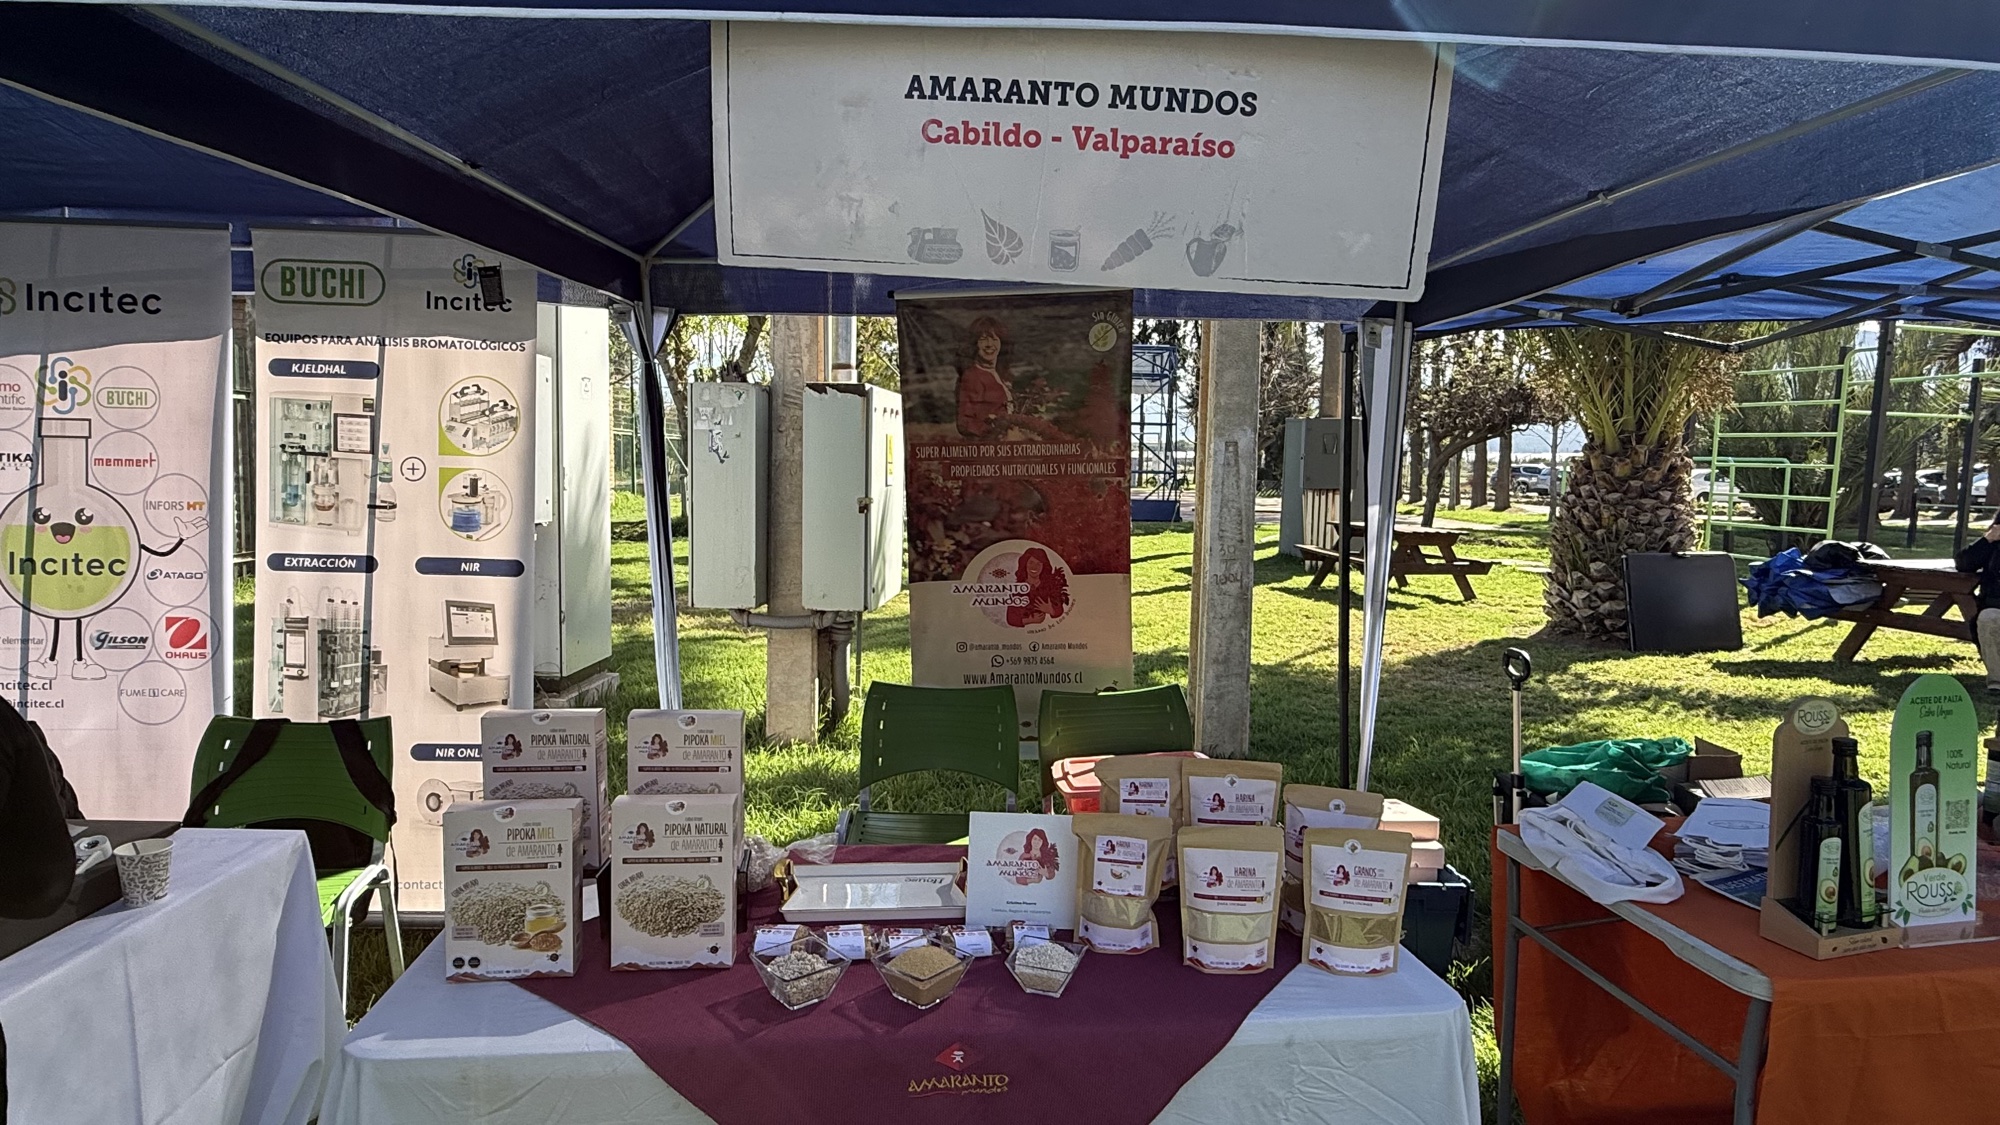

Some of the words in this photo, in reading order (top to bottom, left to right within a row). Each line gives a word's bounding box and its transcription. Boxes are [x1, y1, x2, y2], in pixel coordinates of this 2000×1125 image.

[904, 74, 1100, 108] AMARANTO
[1108, 84, 1258, 117] MUNDOS
[921, 118, 1042, 148] Cabildo
[1072, 126, 1236, 159] Valparaíso
[26, 283, 162, 315] Incitec
[265, 332, 318, 345] EQUIPOS
[321, 334, 352, 346] PARA
[355, 334, 410, 348] ANÁLISIS
[412, 338, 526, 352] BROMATOLÓGICOS
[291, 363, 347, 375] KJELDHAL
[916, 446, 940, 459] SUPER
[941, 445, 978, 458] ALIMENTO
[980, 446, 995, 457] POR
[997, 445, 1011, 457] SUS
[1013, 443, 1081, 456] EXTRAORDINARIAS
[94, 452, 156, 468] memmert
[951, 464, 1000, 477] PROPIEDADES
[1002, 463, 1058, 476] NUTRICIONALES
[1060, 463, 1066, 475] Y
[1067, 462, 1117, 475] FUNCIONALES
[145, 501, 184, 511] INFORS
[186, 501, 206, 511] HT
[8, 551, 127, 577] Incitec
[284, 556, 357, 569] EXTRACCIÓN
[460, 562, 481, 573] NIR
[952, 583, 1030, 594] AMARANTO
[971, 594, 1030, 607] MUNDOS
[2, 636, 44, 645] elementar
[165, 651, 207, 660] OHAUS
[963, 672, 1083, 685] www.AmarantoMundos.cl
[120, 689, 148, 697] FUME
[160, 689, 185, 697] CARE
[1910, 696, 1932, 706] ACEITE
[1933, 695, 1942, 704] DE
[1943, 694, 1963, 704] PALTA
[530, 734, 557, 746] PIPOKA
[559, 733, 591, 746] NATURAL
[683, 734, 710, 746] PIPOKA
[710, 734, 727, 746] MIEL
[435, 747, 456, 758] NIR
[537, 749, 546, 760] de
[547, 748, 582, 760] AMARANTO
[682, 750, 692, 760] de
[692, 749, 727, 760] AMARANTO
[1946, 749, 1964, 759] 100%
[1945, 761, 1971, 770] Natural
[507, 828, 536, 841] PIPOKA
[537, 827, 556, 840] MIEL
[664, 823, 692, 836] PIPOKA
[694, 822, 728, 835] NATURAL
[505, 845, 517, 857] de
[517, 843, 557, 857] AMARANTO
[670, 840, 680, 851] de
[681, 838, 718, 851] AMARANTO
[986, 860, 1039, 868] AMARANTO
[1234, 867, 1256, 877] HARINA
[1354, 865, 1377, 878] GRANOS
[1923, 874, 1947, 882] Verde
[908, 1074, 1009, 1093] AMARANTO
[961, 1086, 1008, 1095] mundos
